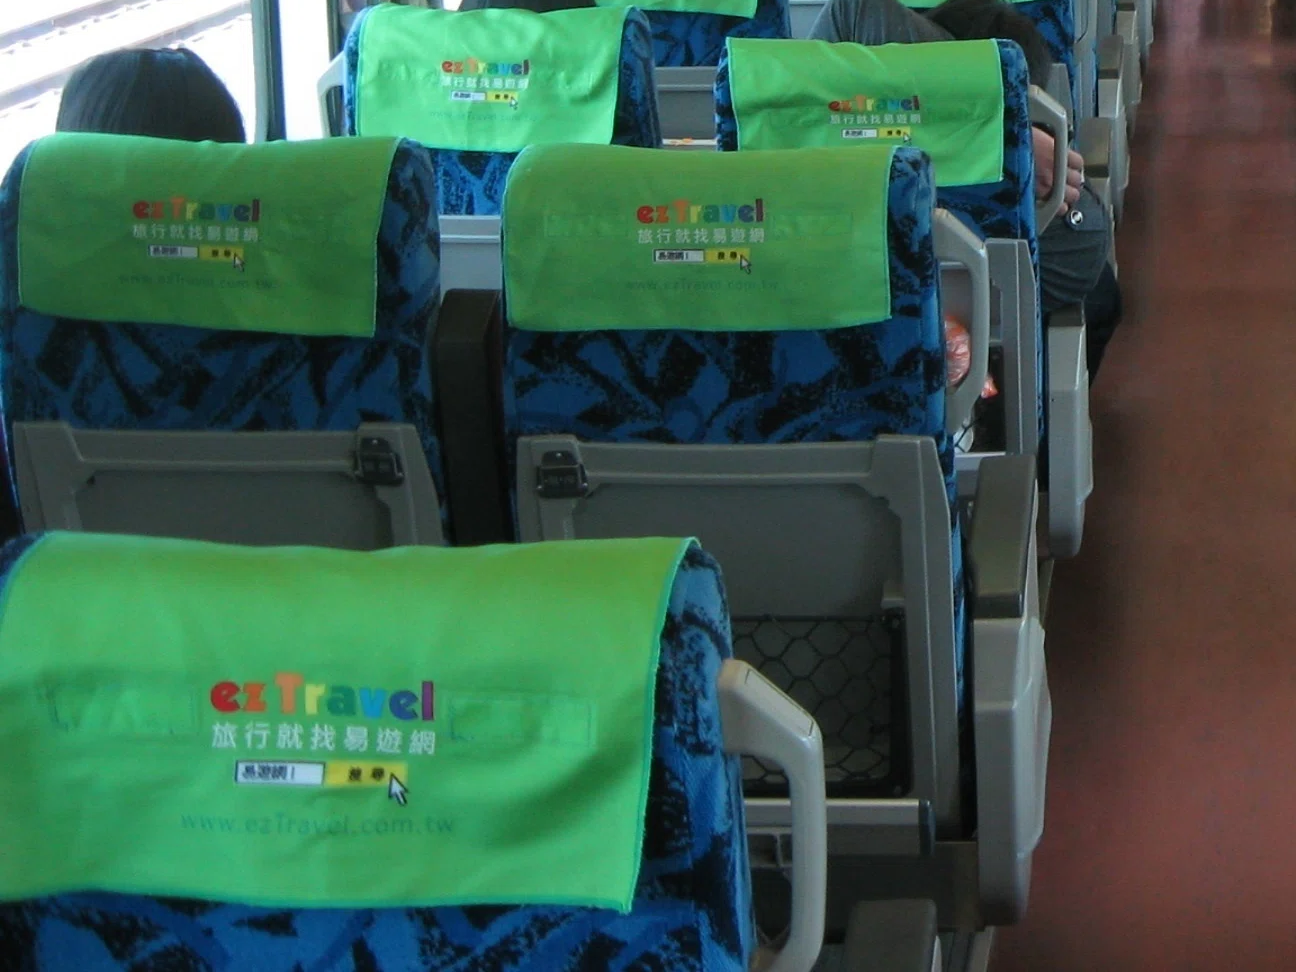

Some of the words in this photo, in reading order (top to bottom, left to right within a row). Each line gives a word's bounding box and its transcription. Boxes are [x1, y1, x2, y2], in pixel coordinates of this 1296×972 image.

[211, 721, 436, 756] 旅行就找易遊網
